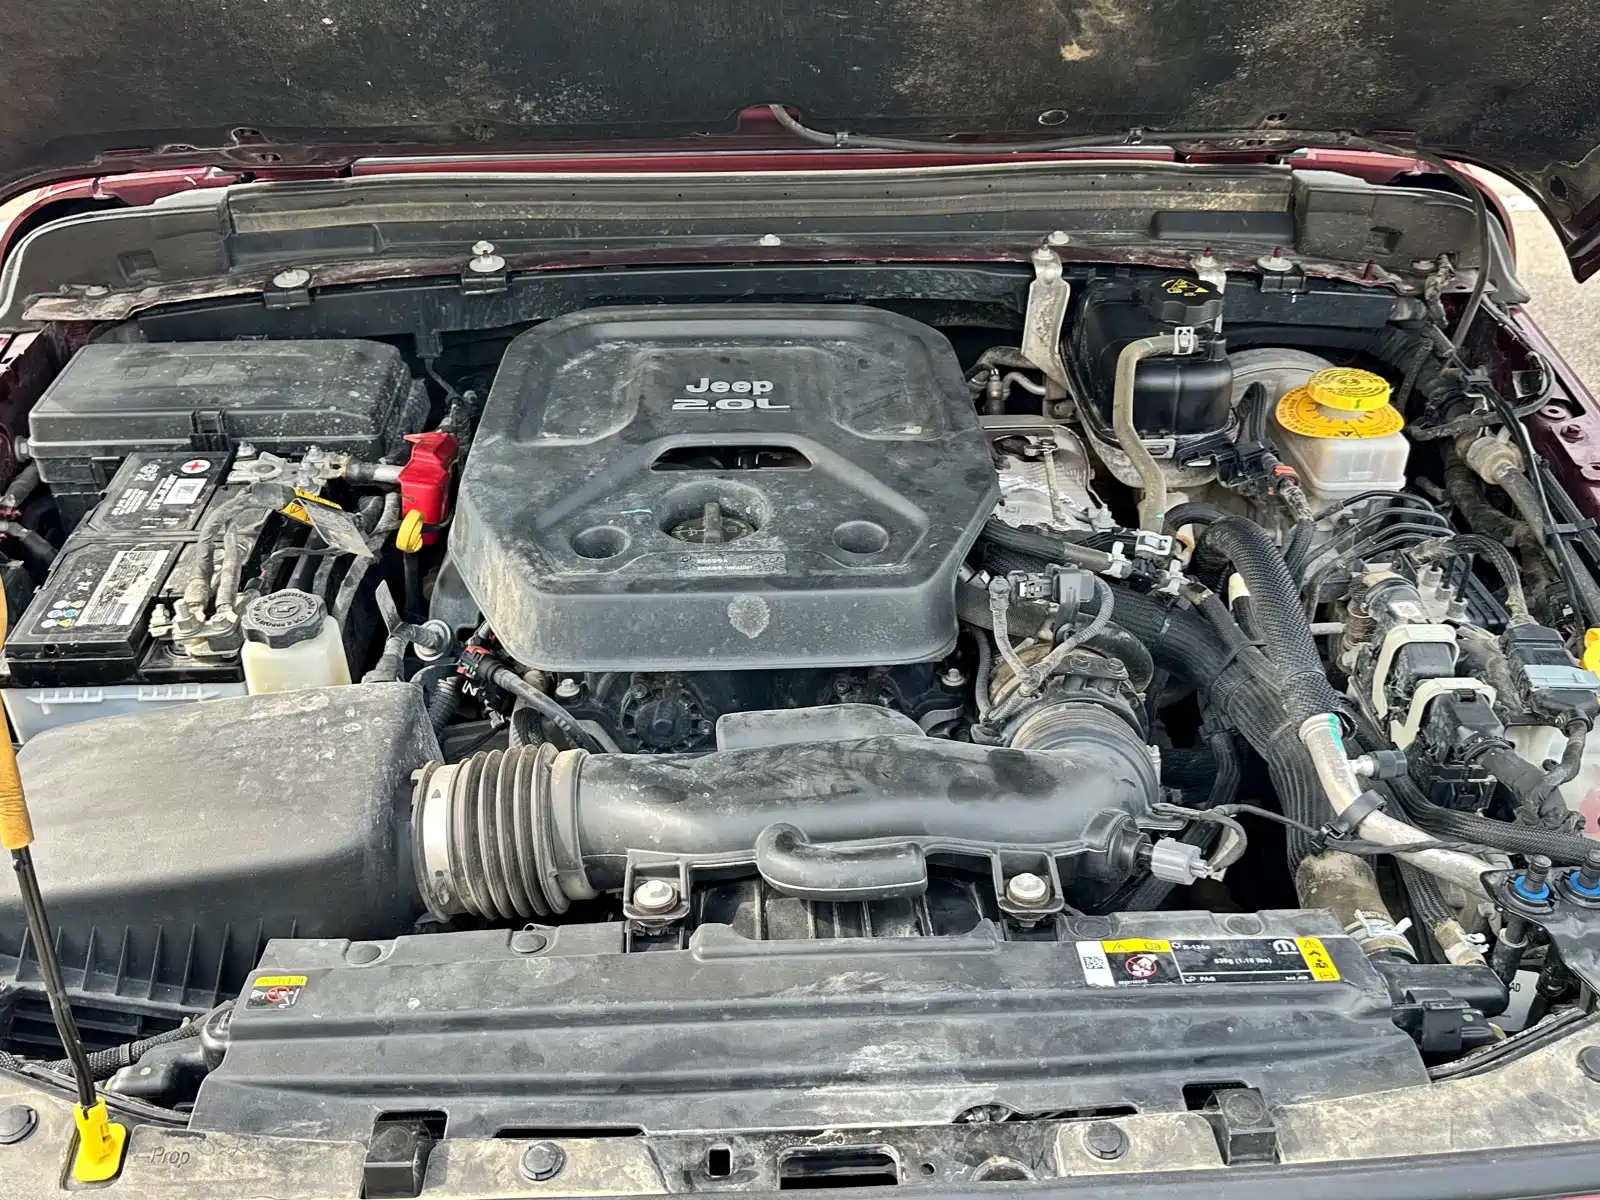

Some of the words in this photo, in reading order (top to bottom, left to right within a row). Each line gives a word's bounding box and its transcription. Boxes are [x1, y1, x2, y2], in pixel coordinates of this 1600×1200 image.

[685, 377, 774, 396] Jeep
[672, 398, 791, 411] 2.0L
[151, 1146, 190, 1168] Prop
